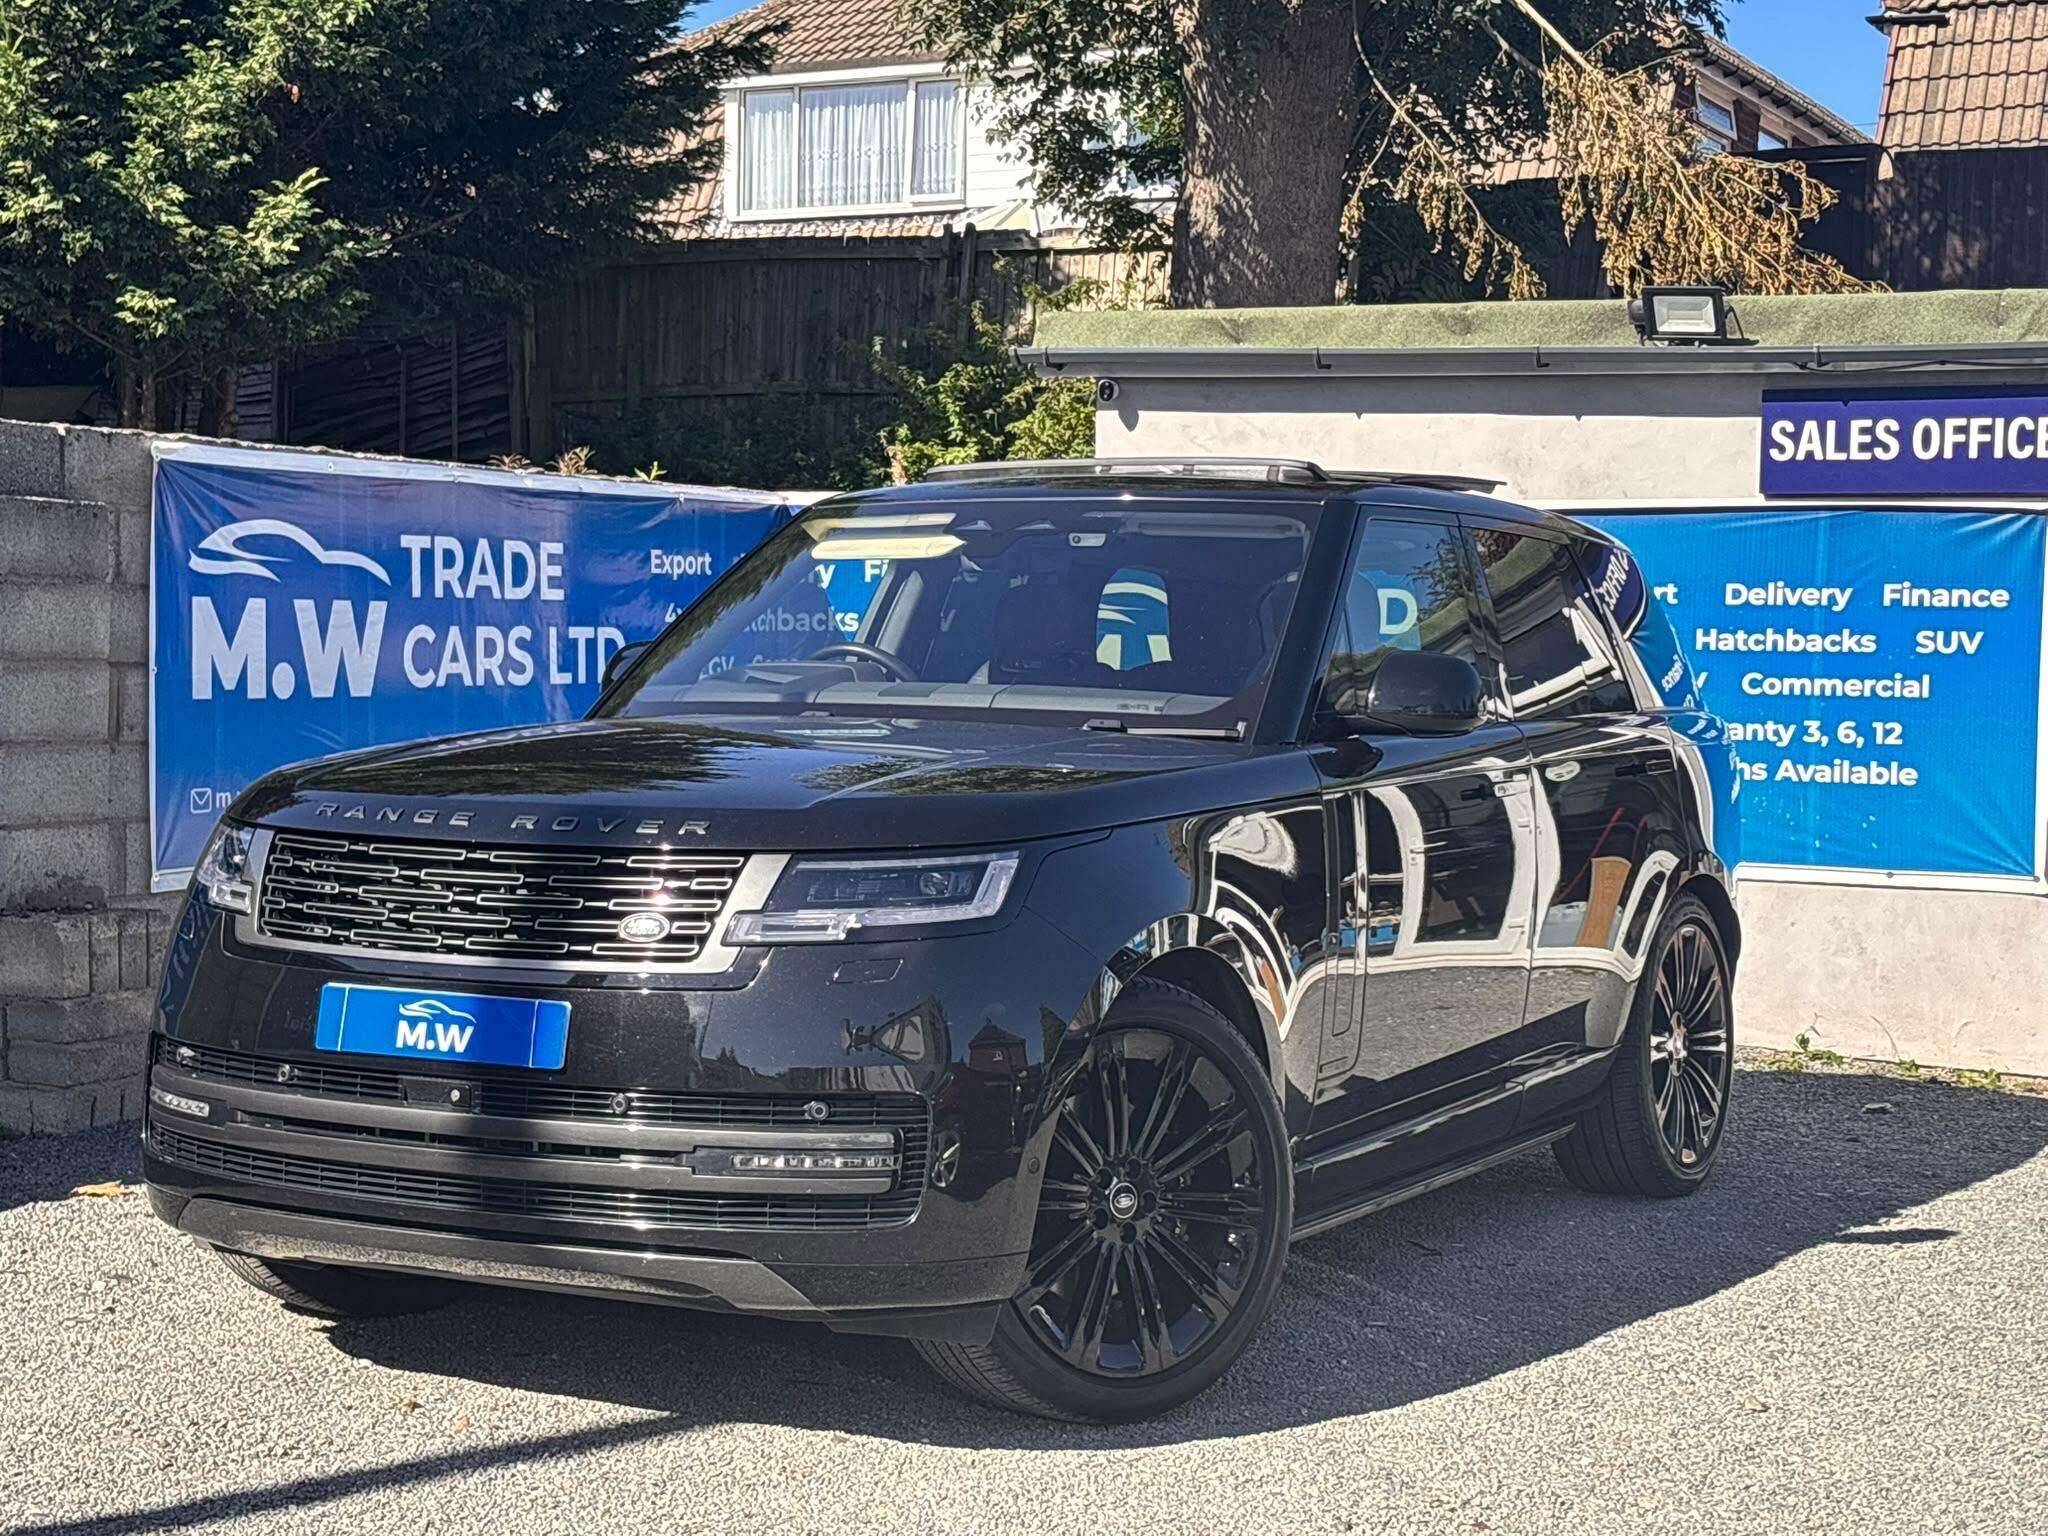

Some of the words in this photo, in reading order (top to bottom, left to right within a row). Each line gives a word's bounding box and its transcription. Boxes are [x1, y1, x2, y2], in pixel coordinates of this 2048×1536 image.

[1769, 419, 1900, 462] SALES
[1912, 415, 2048, 460] OFFICE
[400, 535, 565, 600] TRADE
[650, 548, 713, 581] Export
[1724, 582, 1853, 612] Delivery
[1882, 583, 2010, 608] Finance
[191, 596, 388, 701] M.W
[402, 626, 535, 689] CARS
[548, 625, 626, 685] LTD
[1695, 627, 1877, 654] Hatchbacks
[1916, 631, 1985, 656] SUV
[1741, 671, 1930, 700] Commercial
[1729, 719, 1797, 748] anty
[1802, 720, 1830, 749] 3,
[1837, 722, 1865, 750] 6,
[1872, 722, 1904, 746] 12
[1774, 759, 1919, 786] Available
[315, 801, 475, 827] RANGE
[510, 814, 712, 836] ROVER
[395, 1019, 475, 1053] M.W
